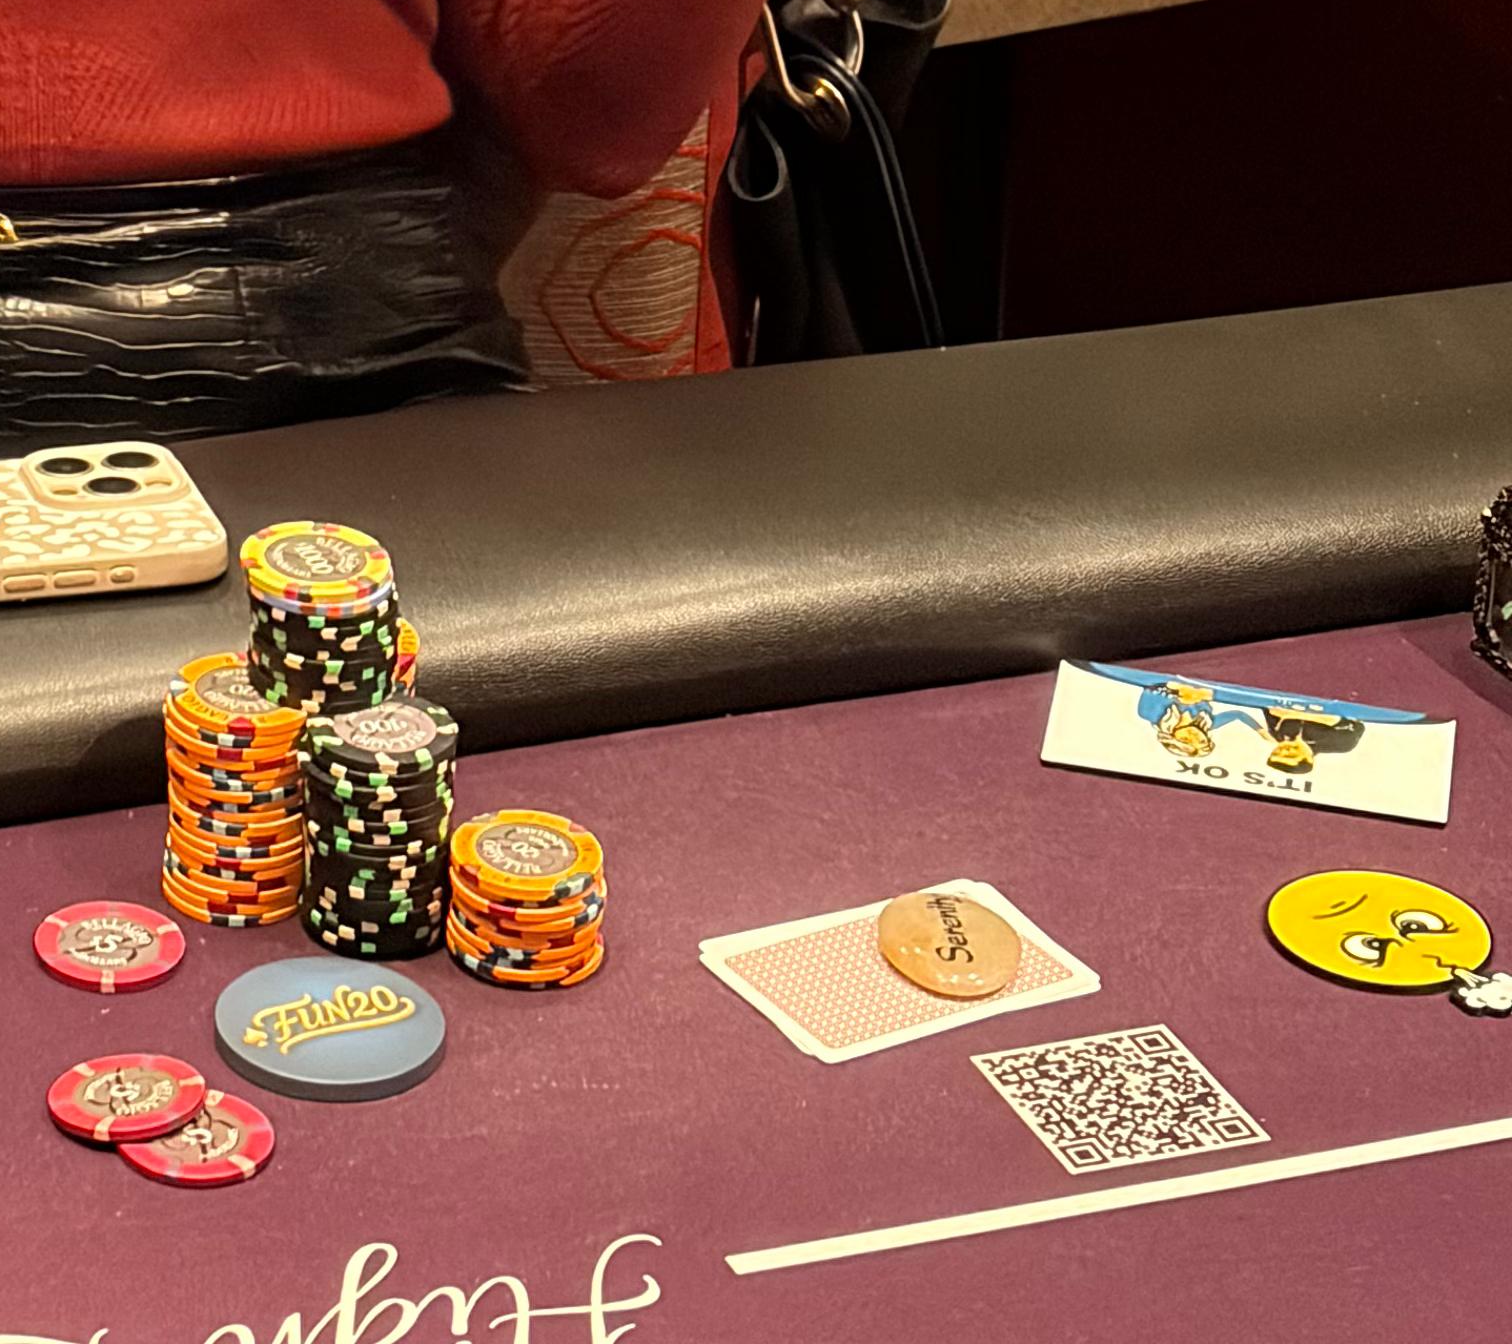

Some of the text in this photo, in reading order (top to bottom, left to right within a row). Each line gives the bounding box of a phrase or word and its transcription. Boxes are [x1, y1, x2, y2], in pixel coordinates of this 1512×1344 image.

[1176, 760, 1313, 793] IT'S OK
[926, 892, 974, 964] Serenity
